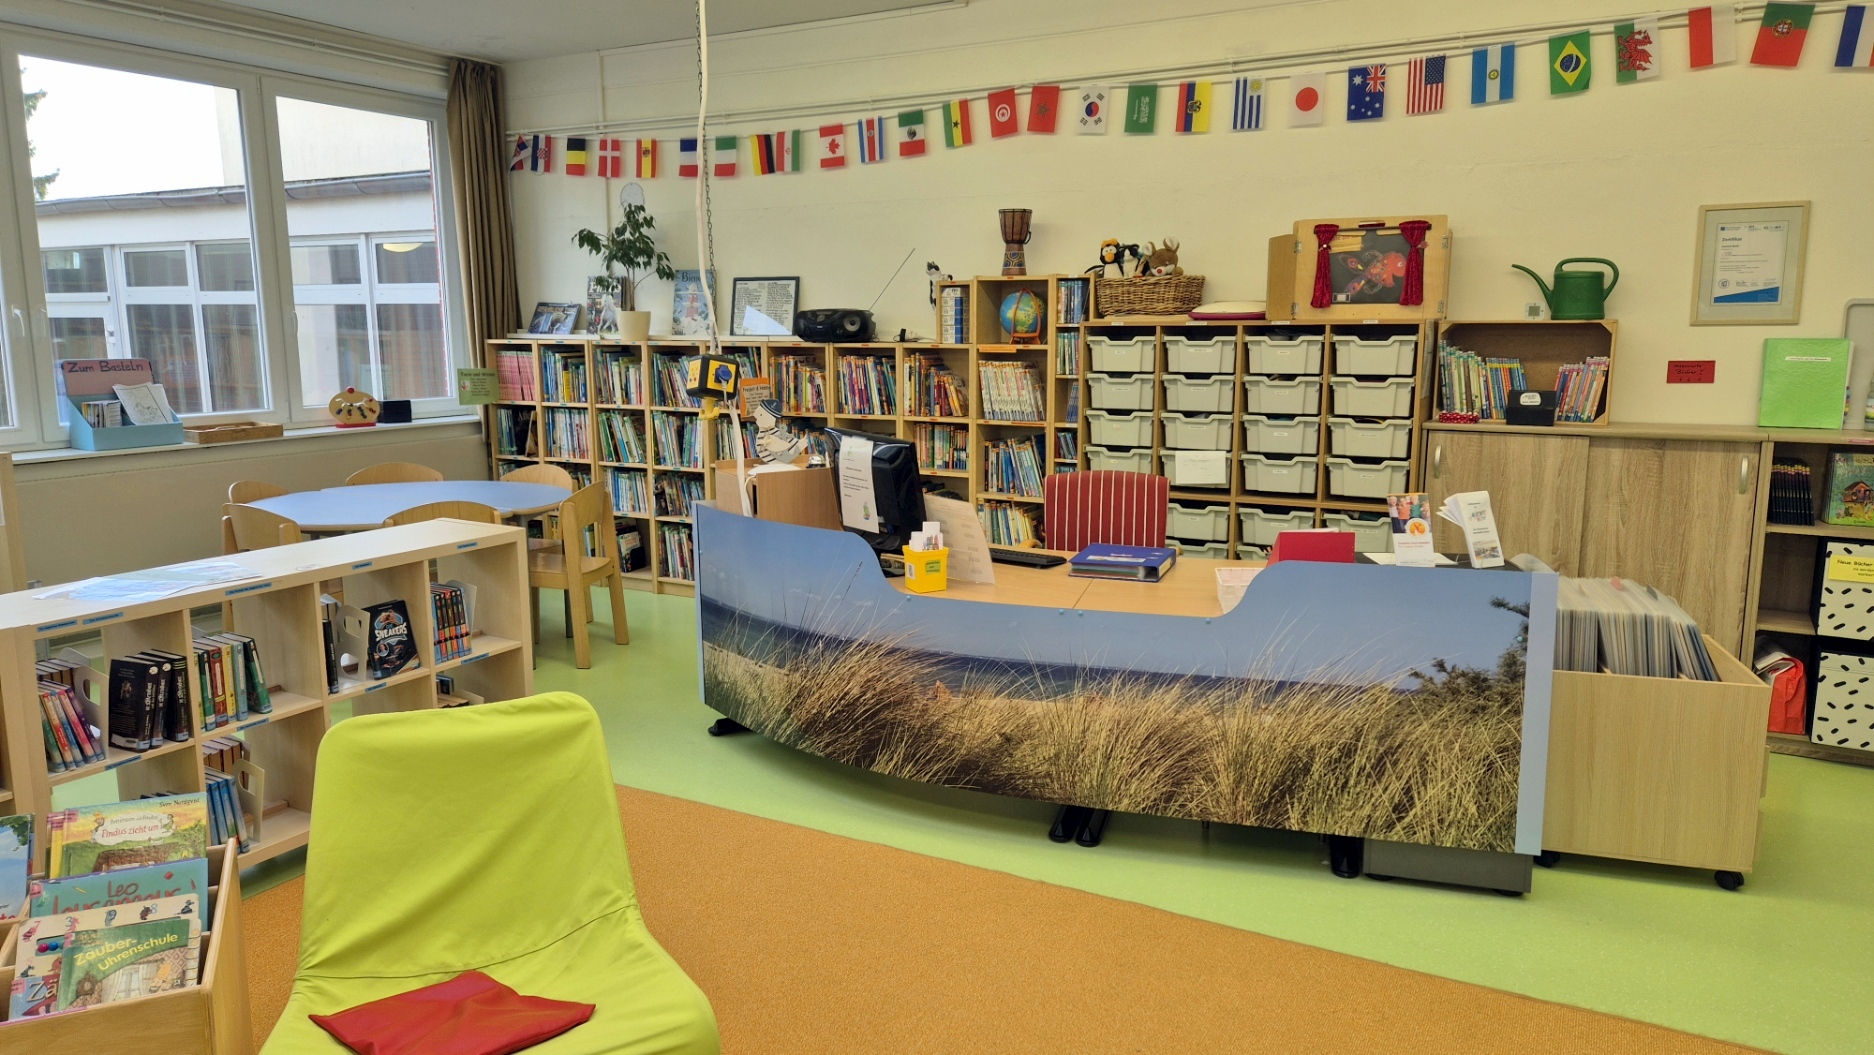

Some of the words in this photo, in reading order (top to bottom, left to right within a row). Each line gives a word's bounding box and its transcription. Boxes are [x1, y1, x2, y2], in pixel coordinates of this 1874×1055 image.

[67, 361, 94, 373] Zum
[99, 360, 144, 373] Basteln
[374, 621, 408, 642] SNEAKERS
[101, 827, 127, 838] Findus
[128, 825, 147, 835] zieht
[148, 824, 159, 832] um
[107, 880, 139, 898] Leo
[73, 938, 138, 966] Zauber-
[97, 933, 179, 971] Uhrenschule
[27, 978, 58, 1003] Zä
